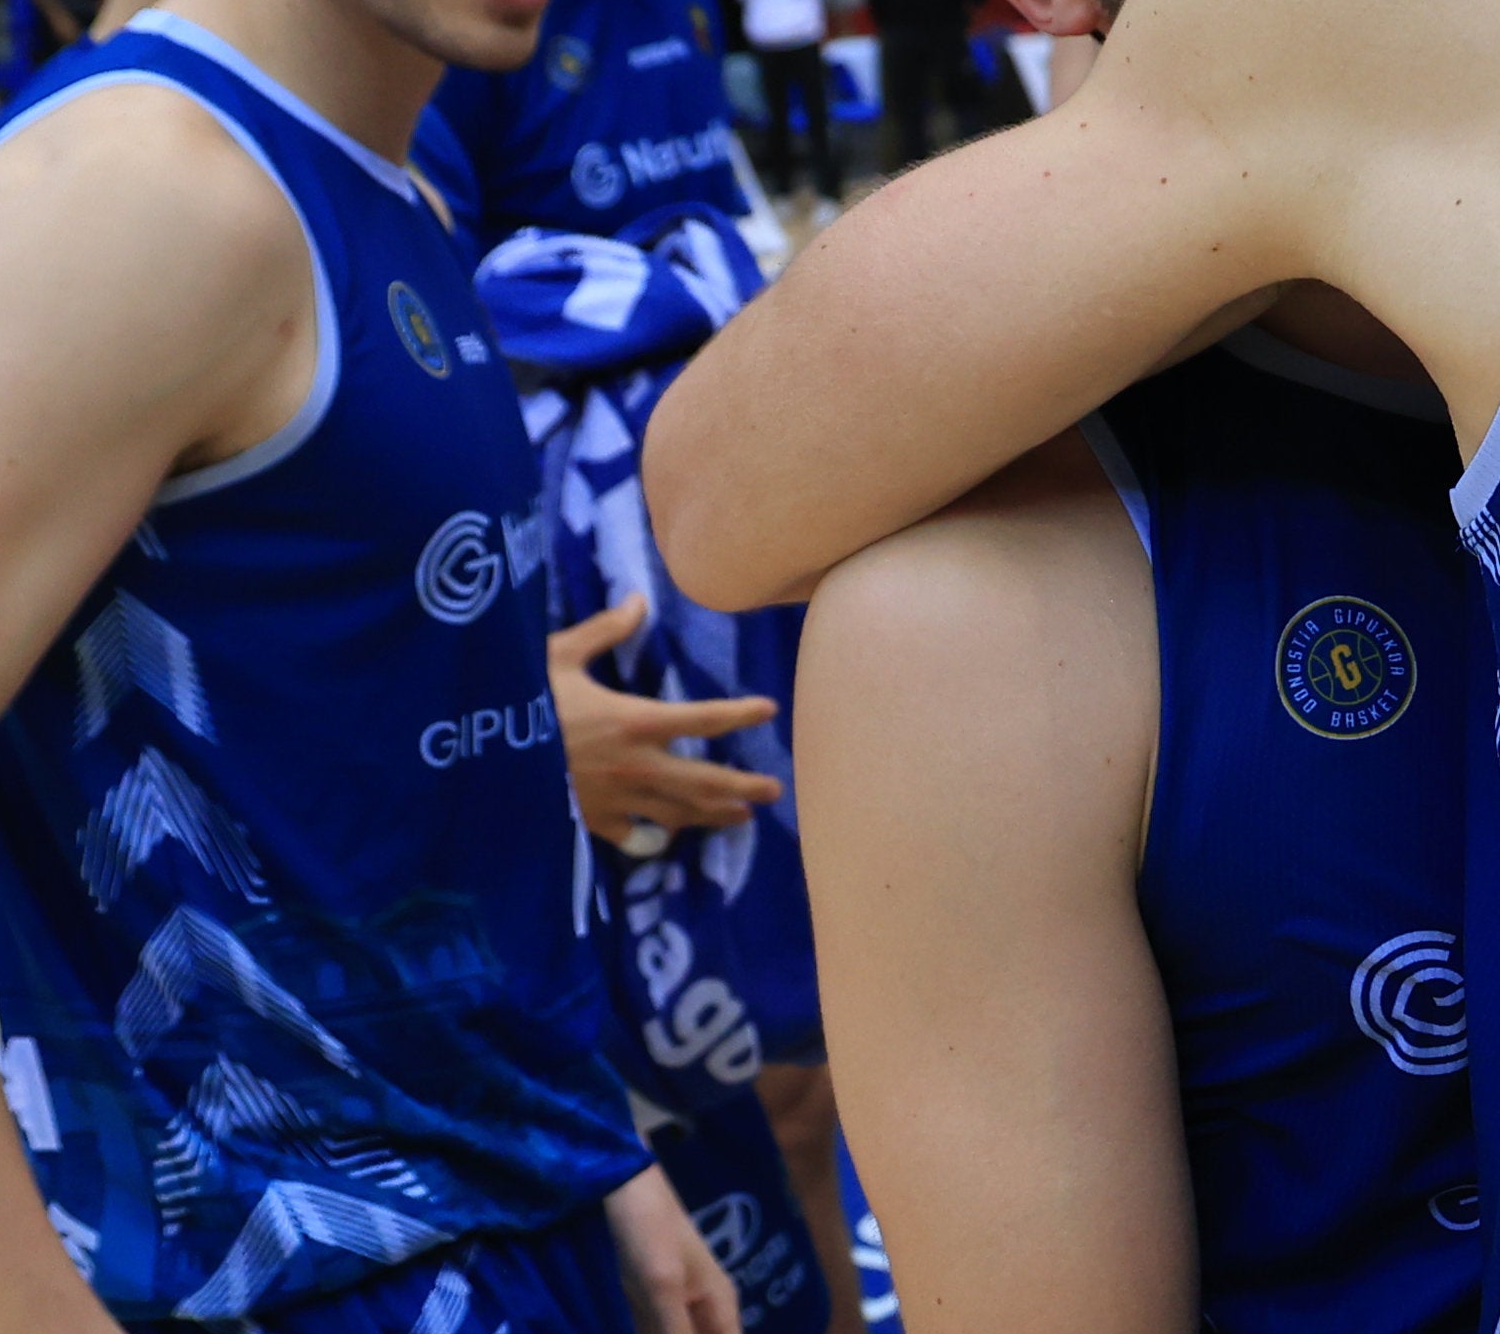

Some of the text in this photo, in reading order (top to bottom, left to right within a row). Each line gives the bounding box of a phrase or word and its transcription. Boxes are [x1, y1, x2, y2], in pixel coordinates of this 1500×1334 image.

[1286, 619, 1320, 714] DONOSTIA
[1333, 608, 1405, 676] GIPUZKOA
[1330, 688, 1399, 729] BASKET
